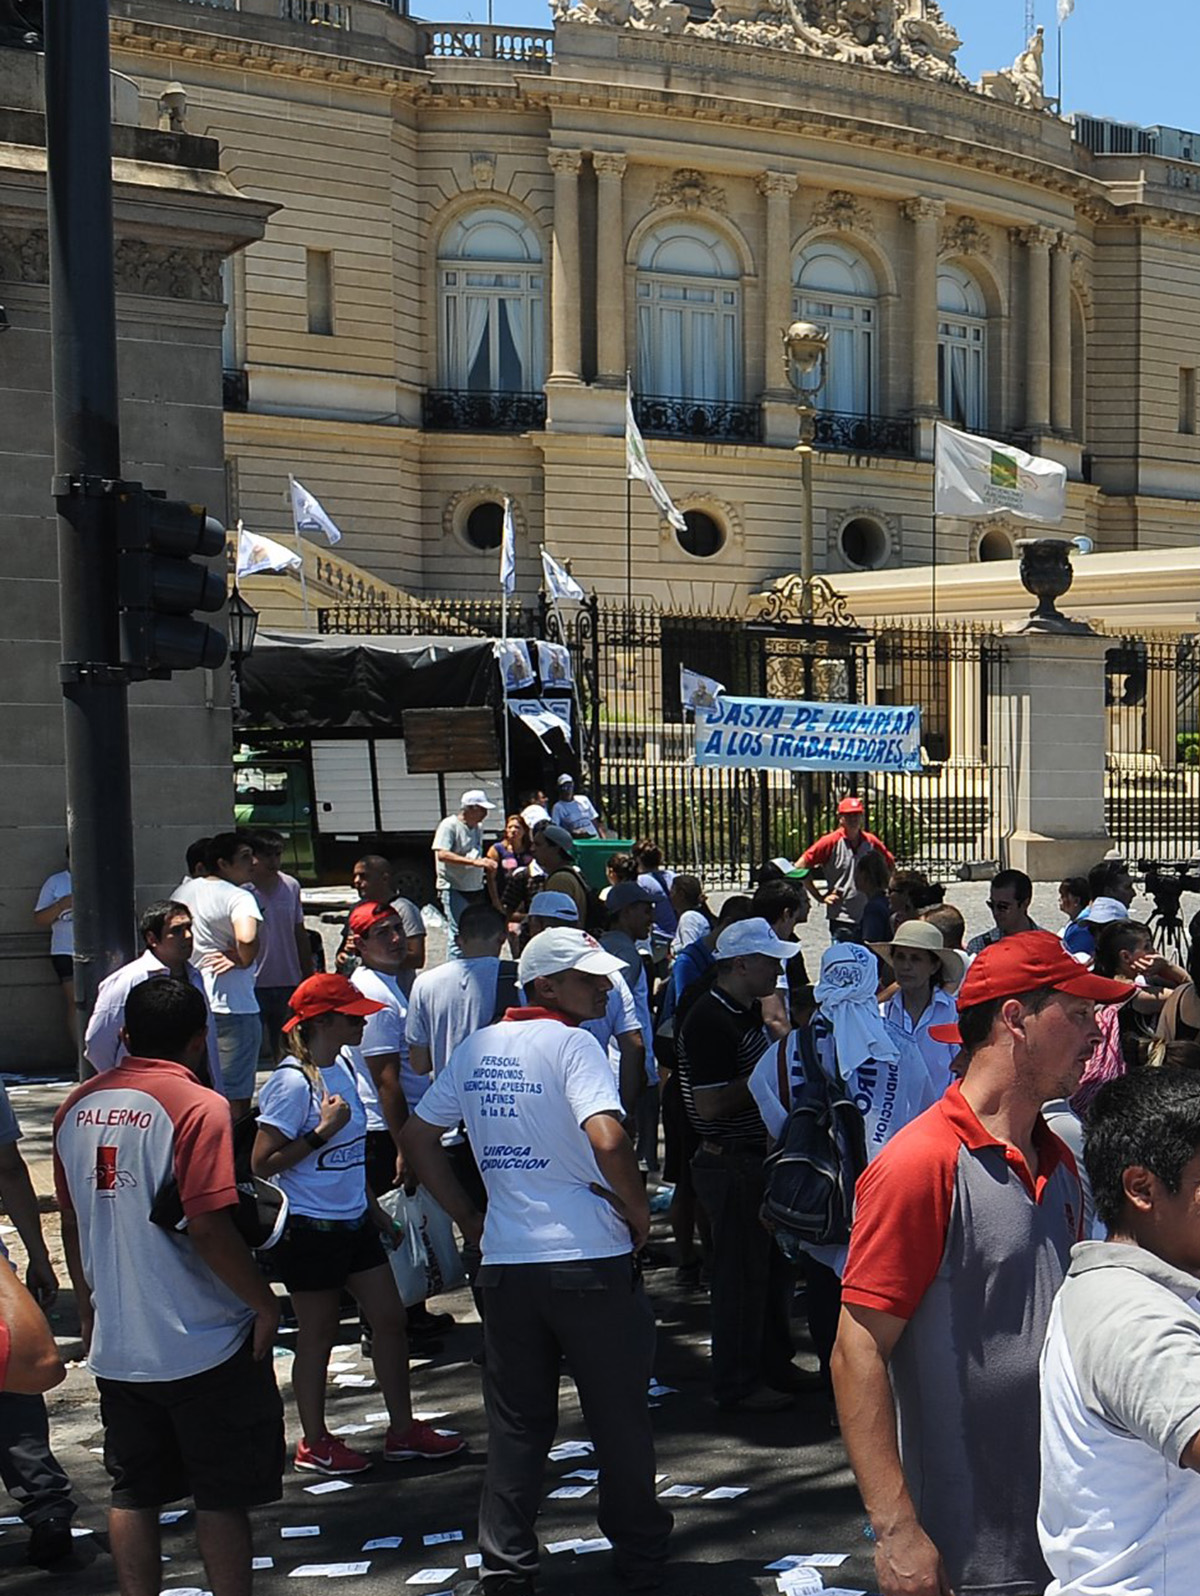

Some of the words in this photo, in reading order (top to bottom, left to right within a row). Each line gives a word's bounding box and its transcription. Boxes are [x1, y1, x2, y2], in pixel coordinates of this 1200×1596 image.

[790, 706, 824, 731] DE
[704, 730, 723, 755] A
[726, 731, 763, 757] LOS
[76, 1109, 152, 1129] PALERMO
[483, 1145, 531, 1157] UIROGA
[480, 1158, 550, 1172] CNDUCCION
